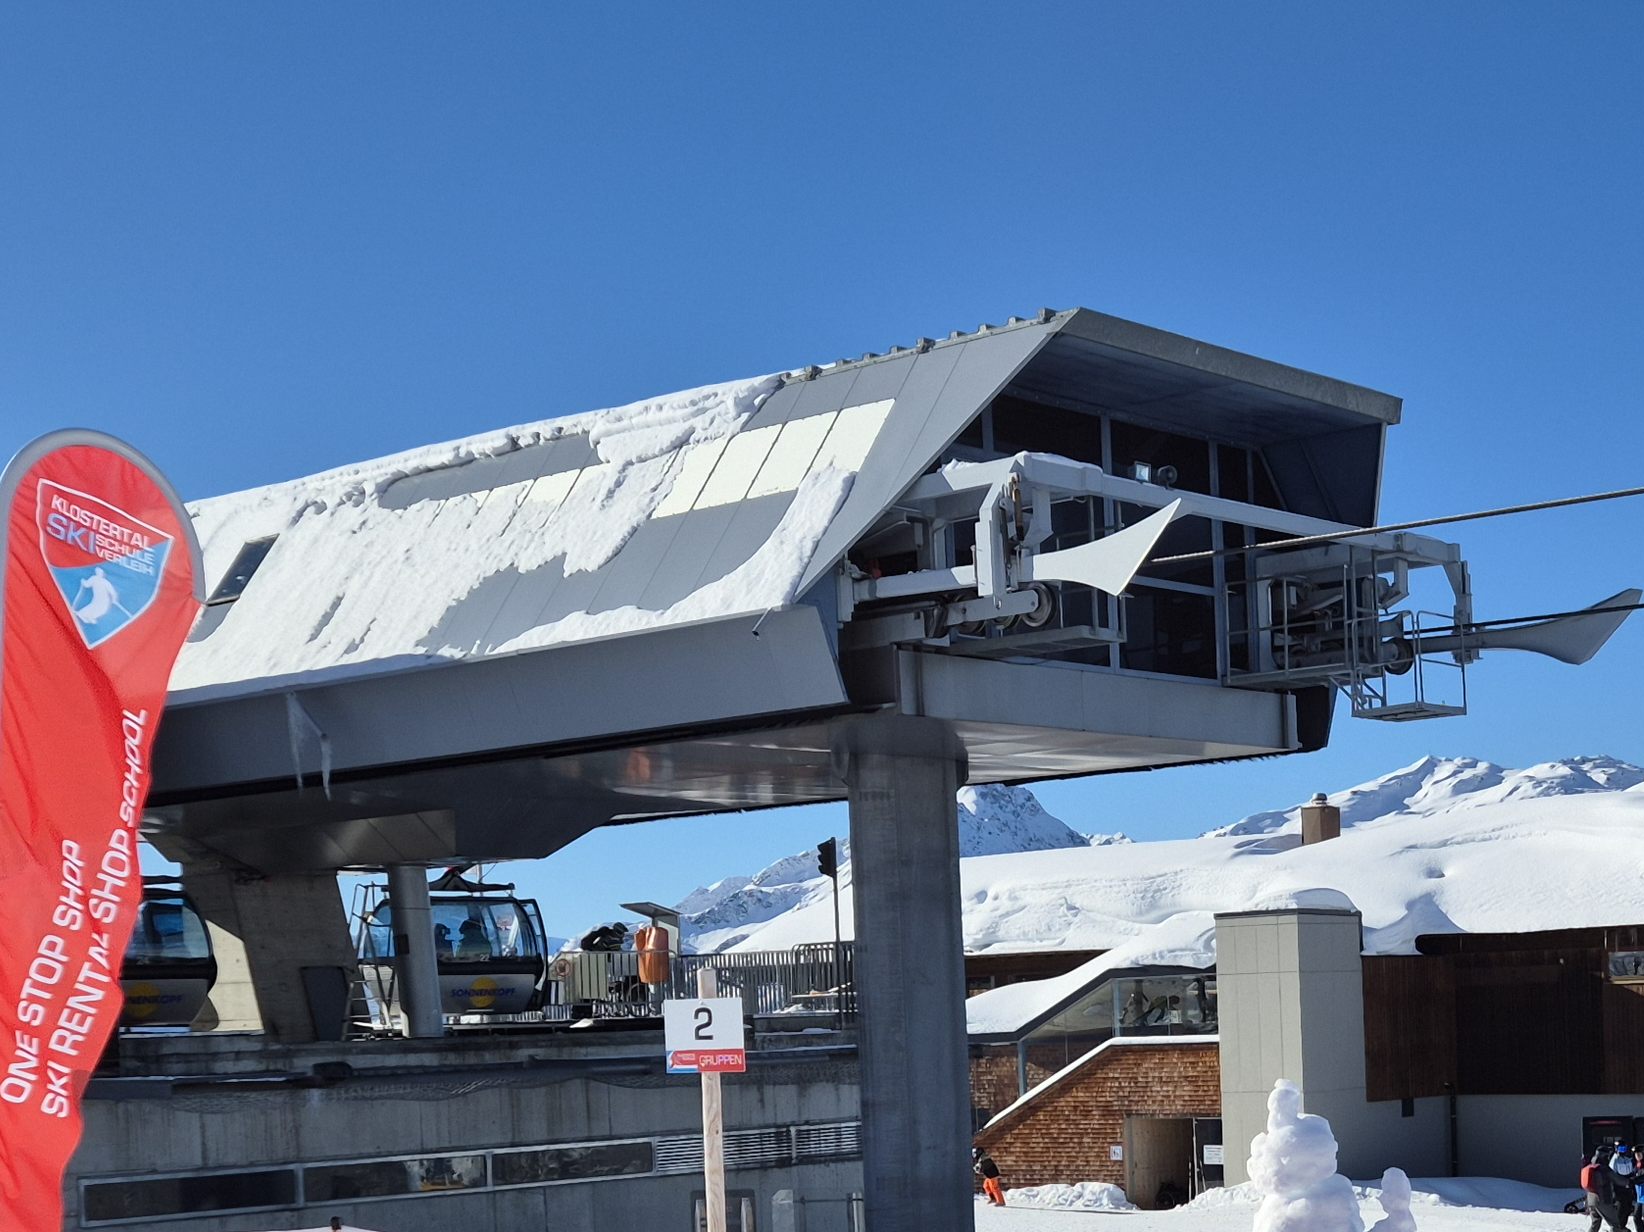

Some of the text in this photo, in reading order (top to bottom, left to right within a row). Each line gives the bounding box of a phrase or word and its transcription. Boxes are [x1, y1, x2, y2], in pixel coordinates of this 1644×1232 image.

[46, 512, 96, 554] SKI
[51, 493, 153, 551] KLOSTERTAL
[95, 534, 155, 563] SCHULE
[95, 548, 154, 576] VERLEIH
[40, 707, 148, 1119] SKI RENTAL SHOP SCHOOL
[0, 840, 86, 1104] ONE STOP SHOP
[693, 1007, 714, 1041] 2
[699, 1054, 742, 1067] GRUPPEN
